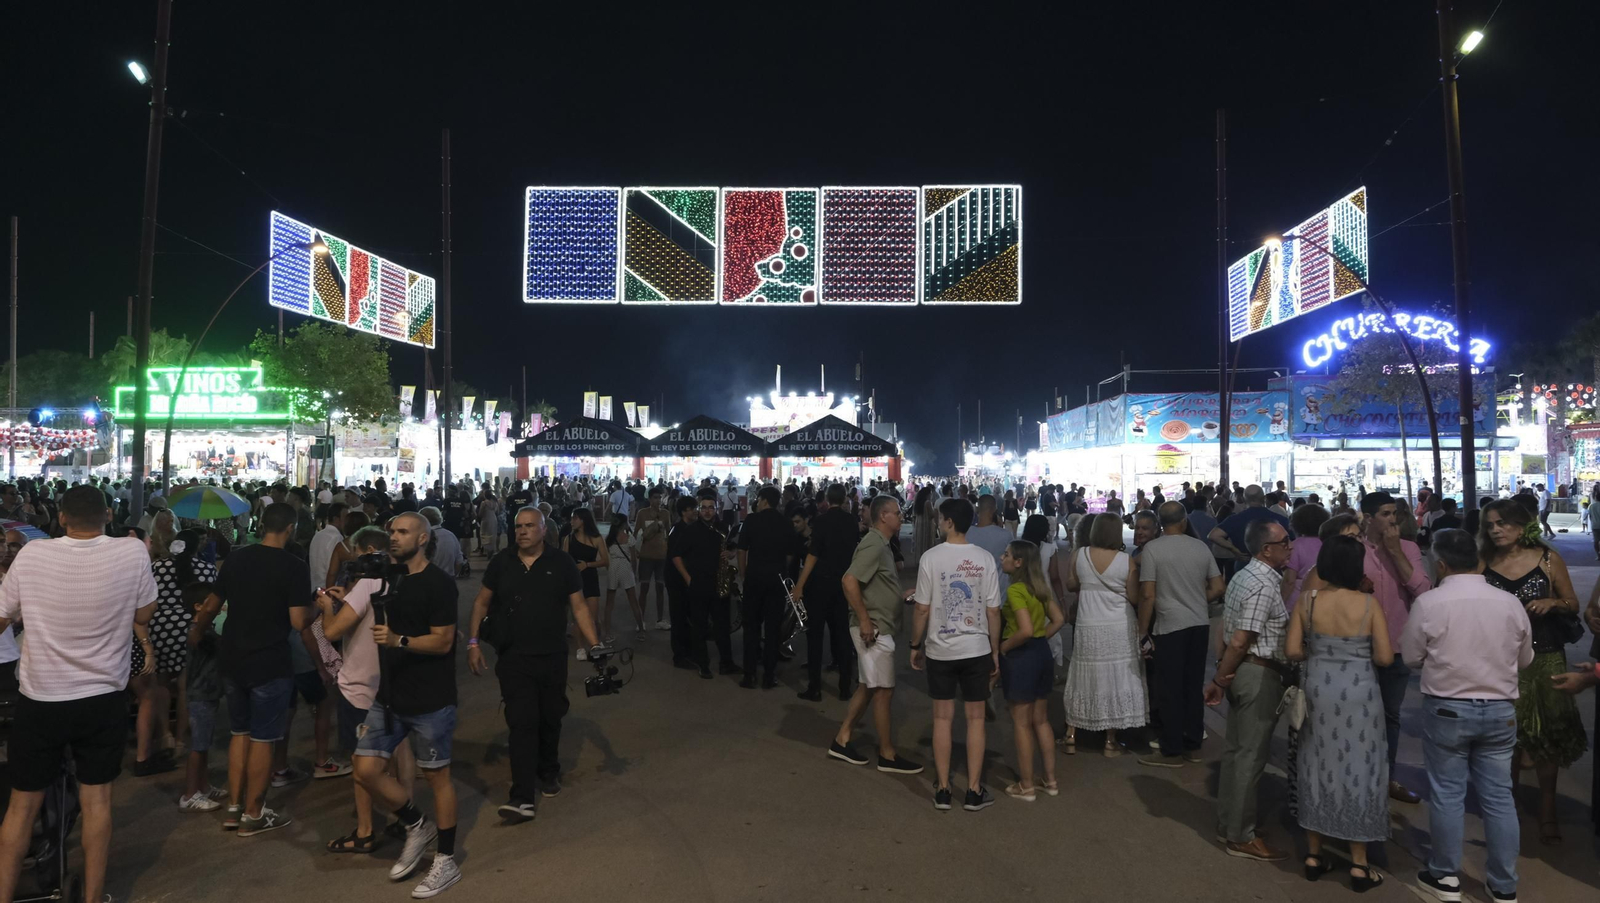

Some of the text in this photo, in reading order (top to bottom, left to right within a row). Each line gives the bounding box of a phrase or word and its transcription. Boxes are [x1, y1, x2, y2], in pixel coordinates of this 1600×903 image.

[165, 373, 242, 394] VINOS
[545, 428, 610, 441] EL ABUELO
[669, 428, 736, 442] EL ABUELO
[796, 428, 864, 442] EL ABUELO
[956, 564, 985, 573] Brooklyn
